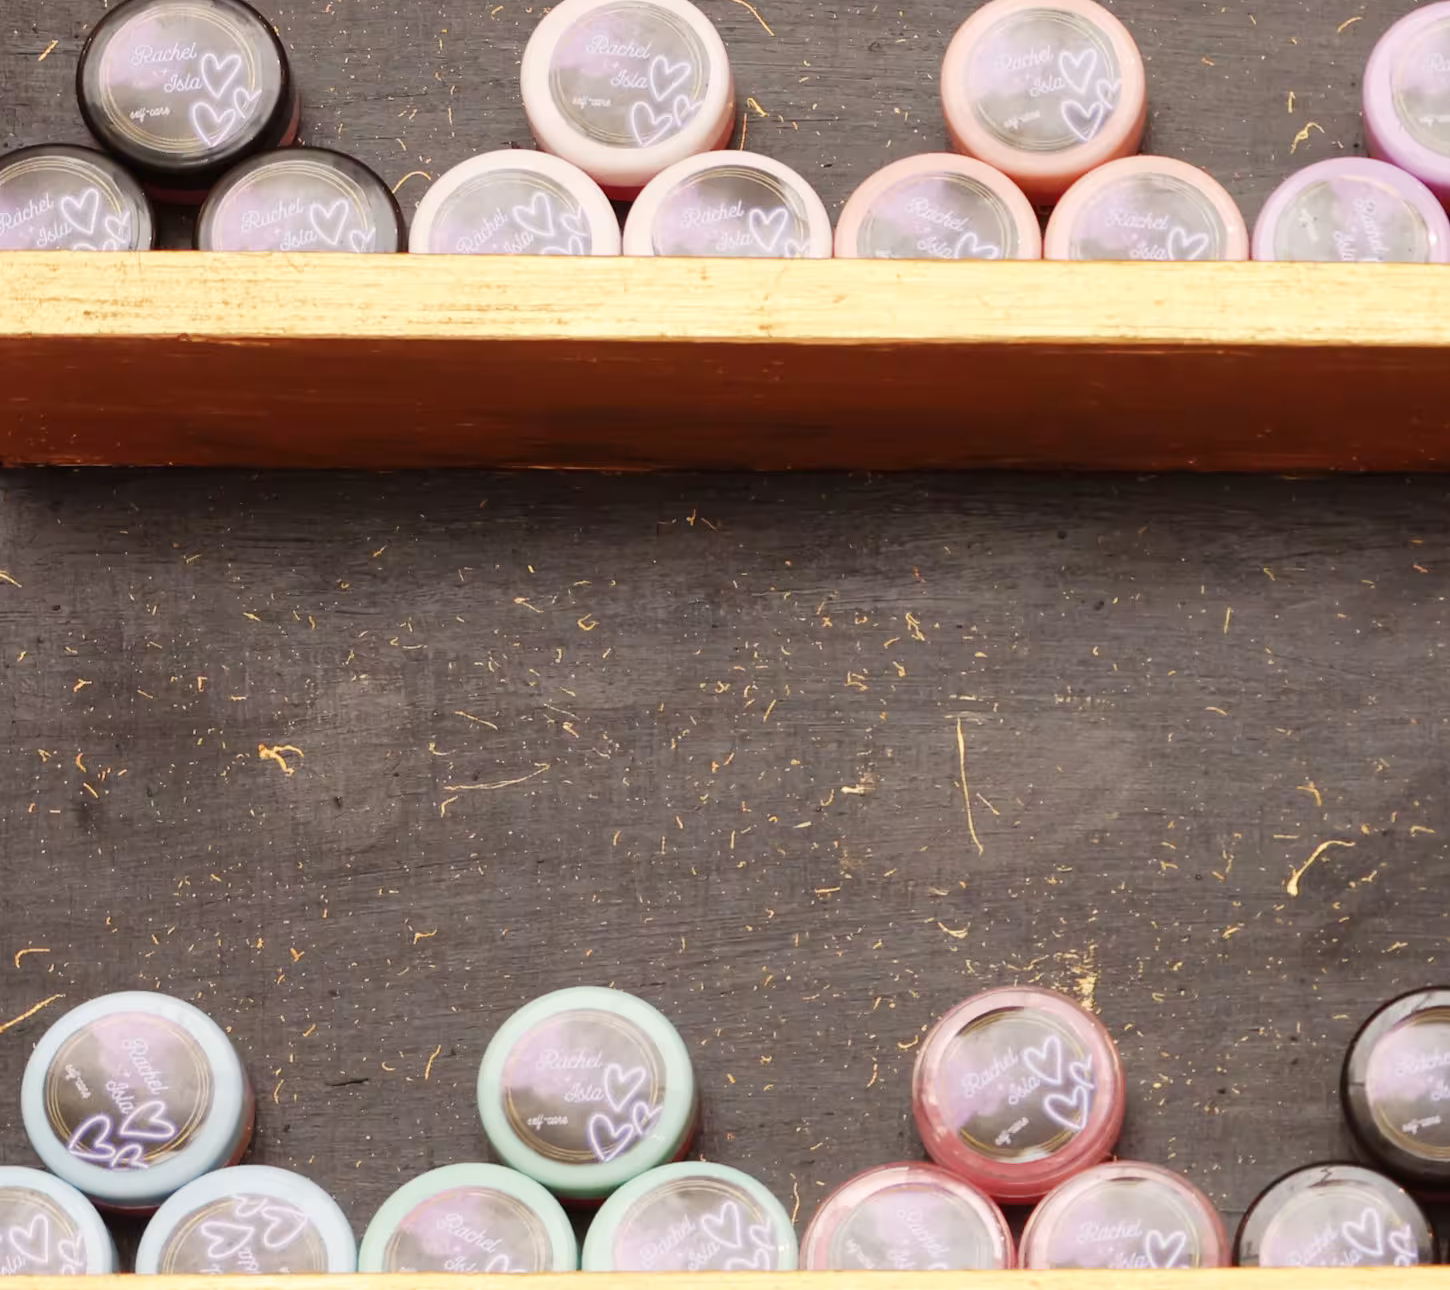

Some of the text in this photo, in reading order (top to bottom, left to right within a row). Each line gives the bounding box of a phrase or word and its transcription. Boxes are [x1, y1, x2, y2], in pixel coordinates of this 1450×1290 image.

[130, 42, 198, 68] Rachel
[586, 35, 651, 59] Rachel
[994, 45, 1055, 72] Rachel
[164, 73, 203, 93] Isla
[609, 69, 649, 90] Isla
[1028, 74, 1066, 98] Isla
[129, 106, 171, 122] self-care
[0, 193, 55, 233] Rachel
[241, 197, 305, 232] Rachel
[680, 199, 745, 226] Rachel
[904, 196, 973, 232] Rachel
[1104, 210, 1170, 231] Rachel
[36, 221, 72, 247] Isla
[279, 230, 318, 250] Isla
[457, 207, 510, 254] Rachel
[715, 230, 754, 252] Isla
[1129, 240, 1167, 260] Isla
[122, 1037, 169, 1096] Rachel
[535, 1049, 603, 1071] Rachel
[960, 1047, 1020, 1099] Rachel
[105, 1079, 135, 1115] Isla
[563, 1084, 605, 1103] Isla
[1007, 1075, 1041, 1106] Isla
[527, 1113, 568, 1130] self-care
[436, 1212, 503, 1254] Rachel
[638, 1214, 698, 1268] Rachel
[1076, 1221, 1143, 1243] Rachel
